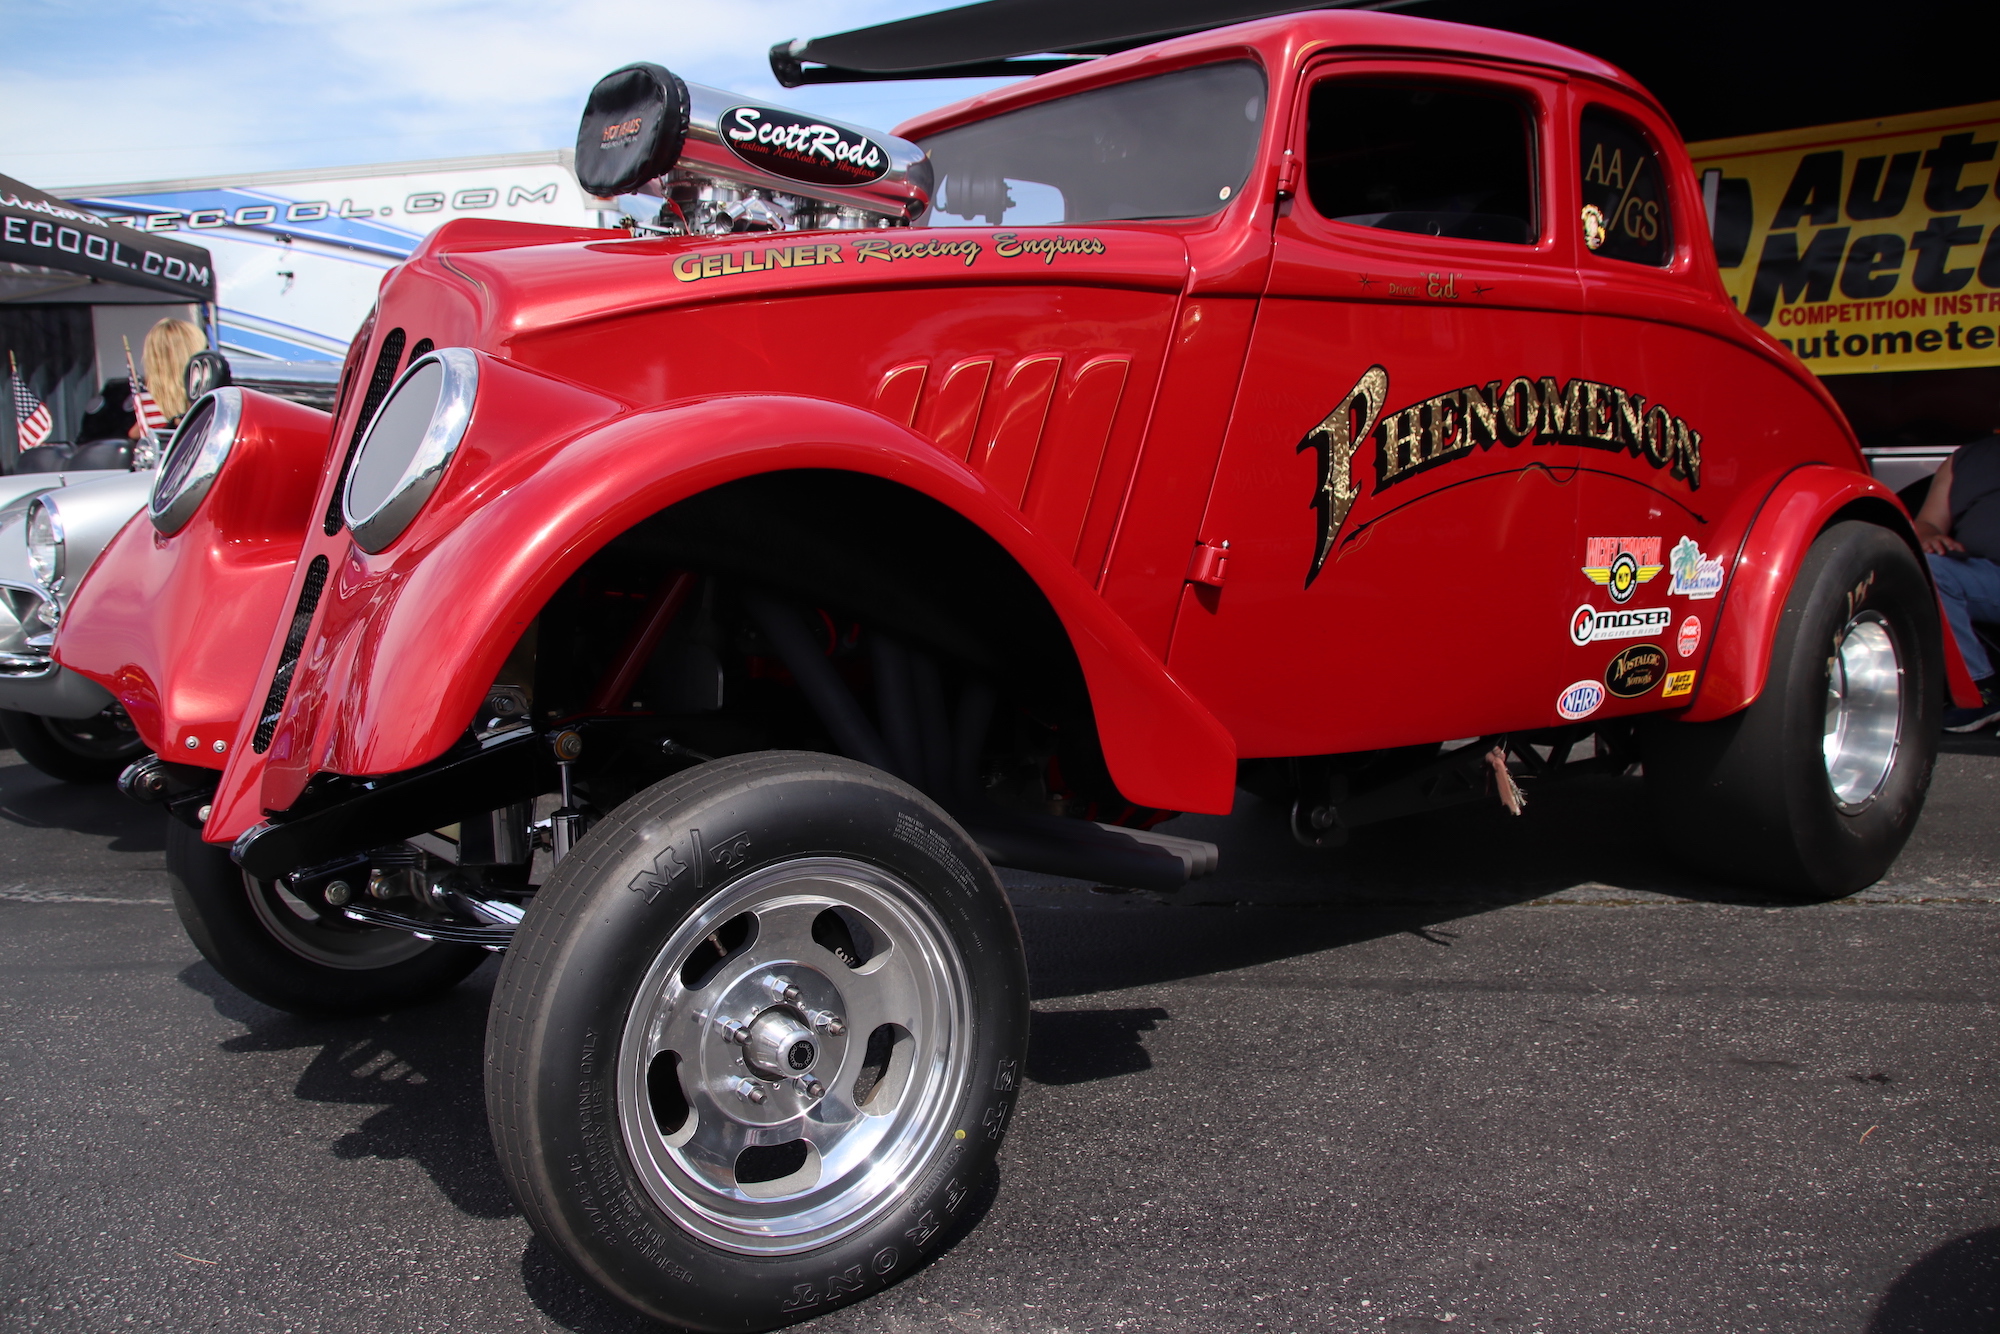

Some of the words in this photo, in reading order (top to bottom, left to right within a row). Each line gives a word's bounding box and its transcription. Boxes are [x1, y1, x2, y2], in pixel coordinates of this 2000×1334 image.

[729, 108, 880, 168] ScottRods
[733, 137, 770, 154] Custom
[820, 157, 830, 168] &
[834, 160, 877, 178] Fiberglass
[1769, 131, 2000, 231] Aut
[672, 243, 843, 282] GELLNER
[852, 238, 982, 266] Racing
[992, 232, 1106, 265] Engines
[1778, 298, 1926, 327] COMPETITION
[1779, 321, 2000, 359] utomete
[1296, 363, 1702, 591] PHENOMENON
[1594, 627, 1661, 639] ENGINEERING
[1595, 611, 1670, 629] MOSER
[1565, 687, 1600, 712] NHRA
